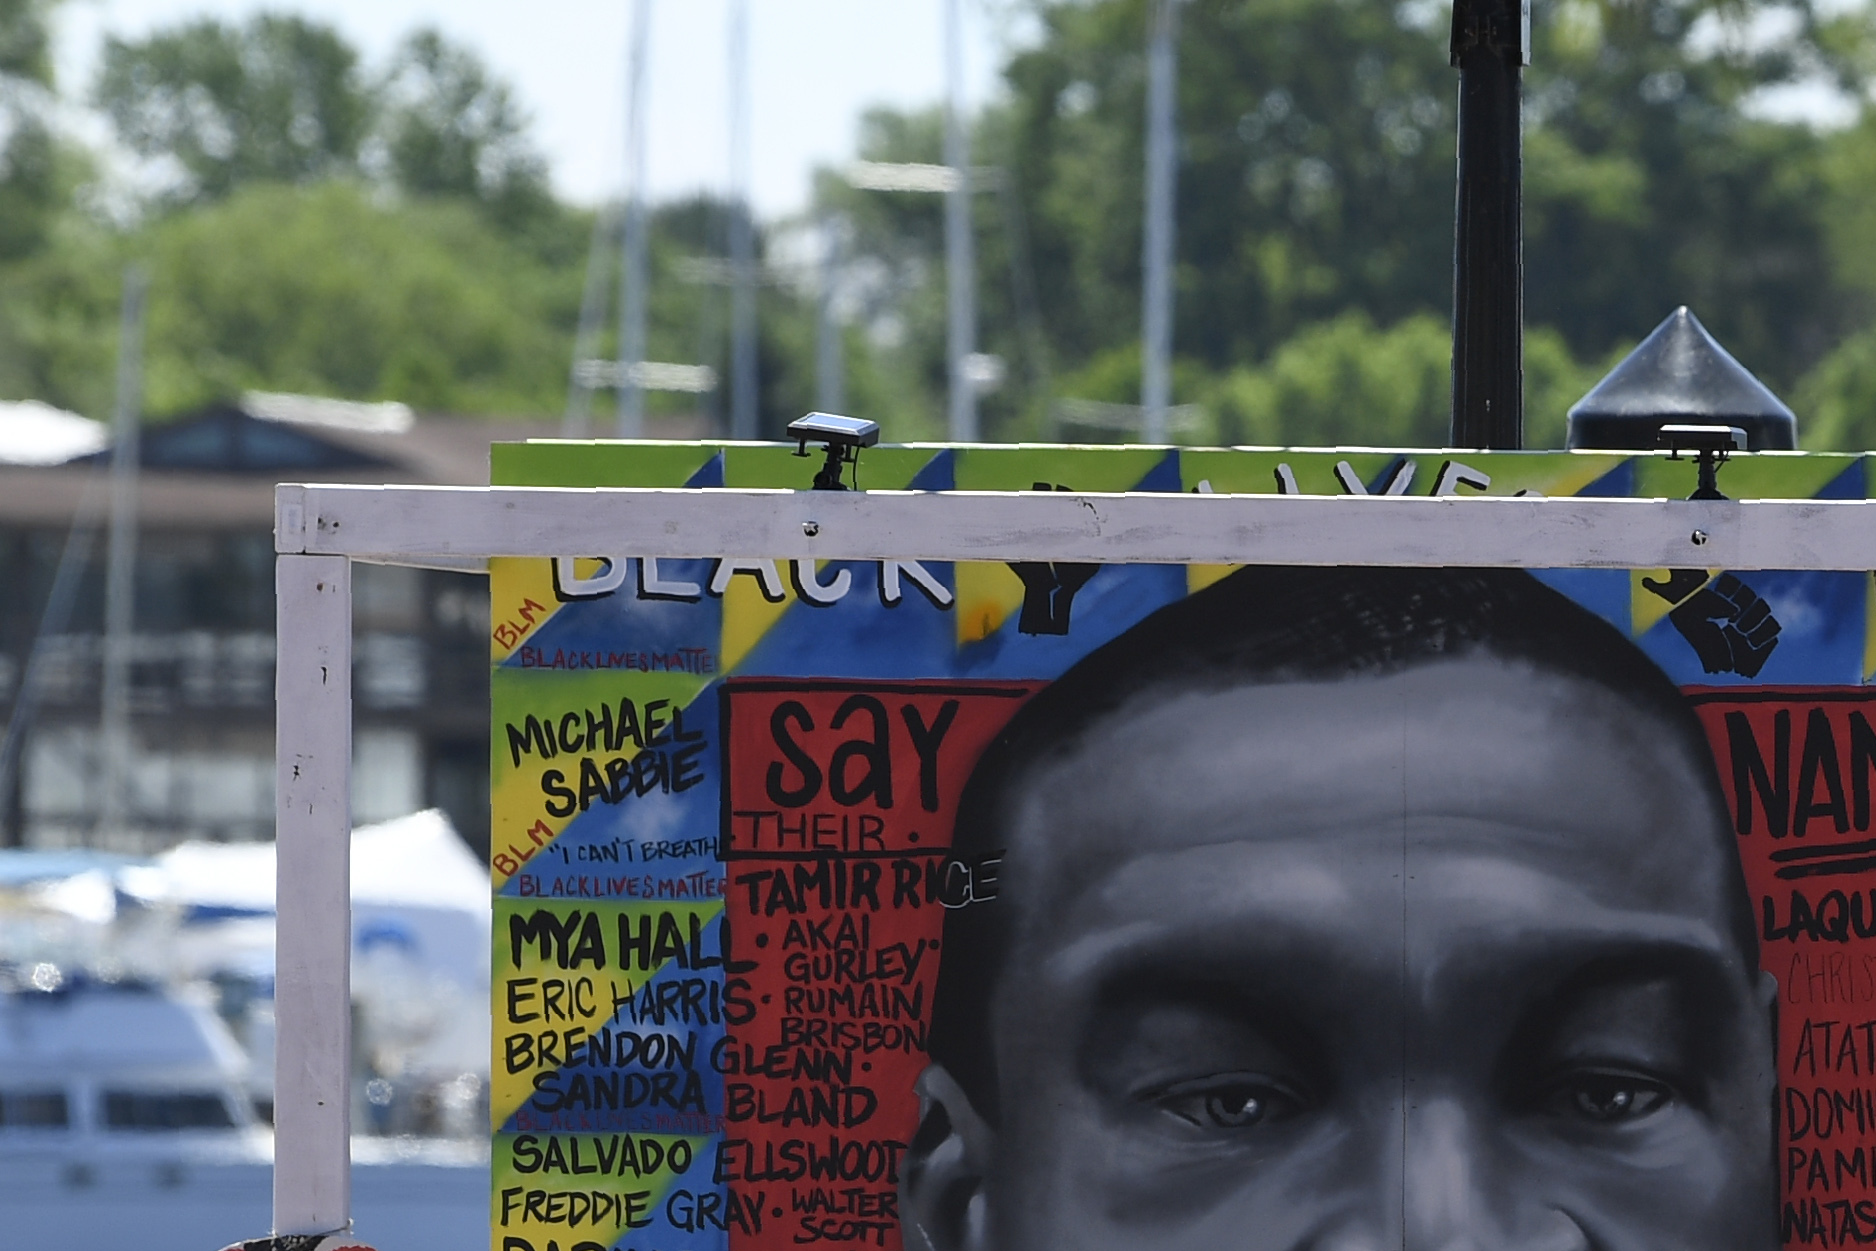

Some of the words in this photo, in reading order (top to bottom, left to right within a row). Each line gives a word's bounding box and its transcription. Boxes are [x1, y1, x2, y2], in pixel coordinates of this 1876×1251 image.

[492, 598, 545, 650] BLM
[506, 697, 706, 768] MICHAEL
[541, 741, 706, 818] SABBIE
[491, 819, 555, 876] BLM
[577, 839, 635, 862] CAN'T
[734, 810, 884, 850] THEIR
[736, 859, 882, 917] TAMIR
[892, 849, 1007, 909] RICE
[509, 910, 606, 970] MYA
[618, 909, 759, 974] HALL
[781, 913, 870, 951] AKAI
[784, 940, 925, 986] GURLEY
[506, 977, 597, 1023] ERIC
[610, 977, 756, 1026] HARRIS
[784, 985, 923, 1020] RUMAIN
[505, 1030, 695, 1075] BRENDON
[710, 1037, 852, 1085] GLENN
[780, 1017, 929, 1054] BRISBON
[532, 1070, 706, 1113] SANDRA
[726, 1082, 878, 1130] BLAND
[511, 1133, 692, 1175] SALVADO
[500, 1186, 653, 1228] FREDDIE
[666, 1188, 765, 1236] GRAY
[793, 1187, 898, 1219] WALTER
[794, 1216, 893, 1247] SCOTT
